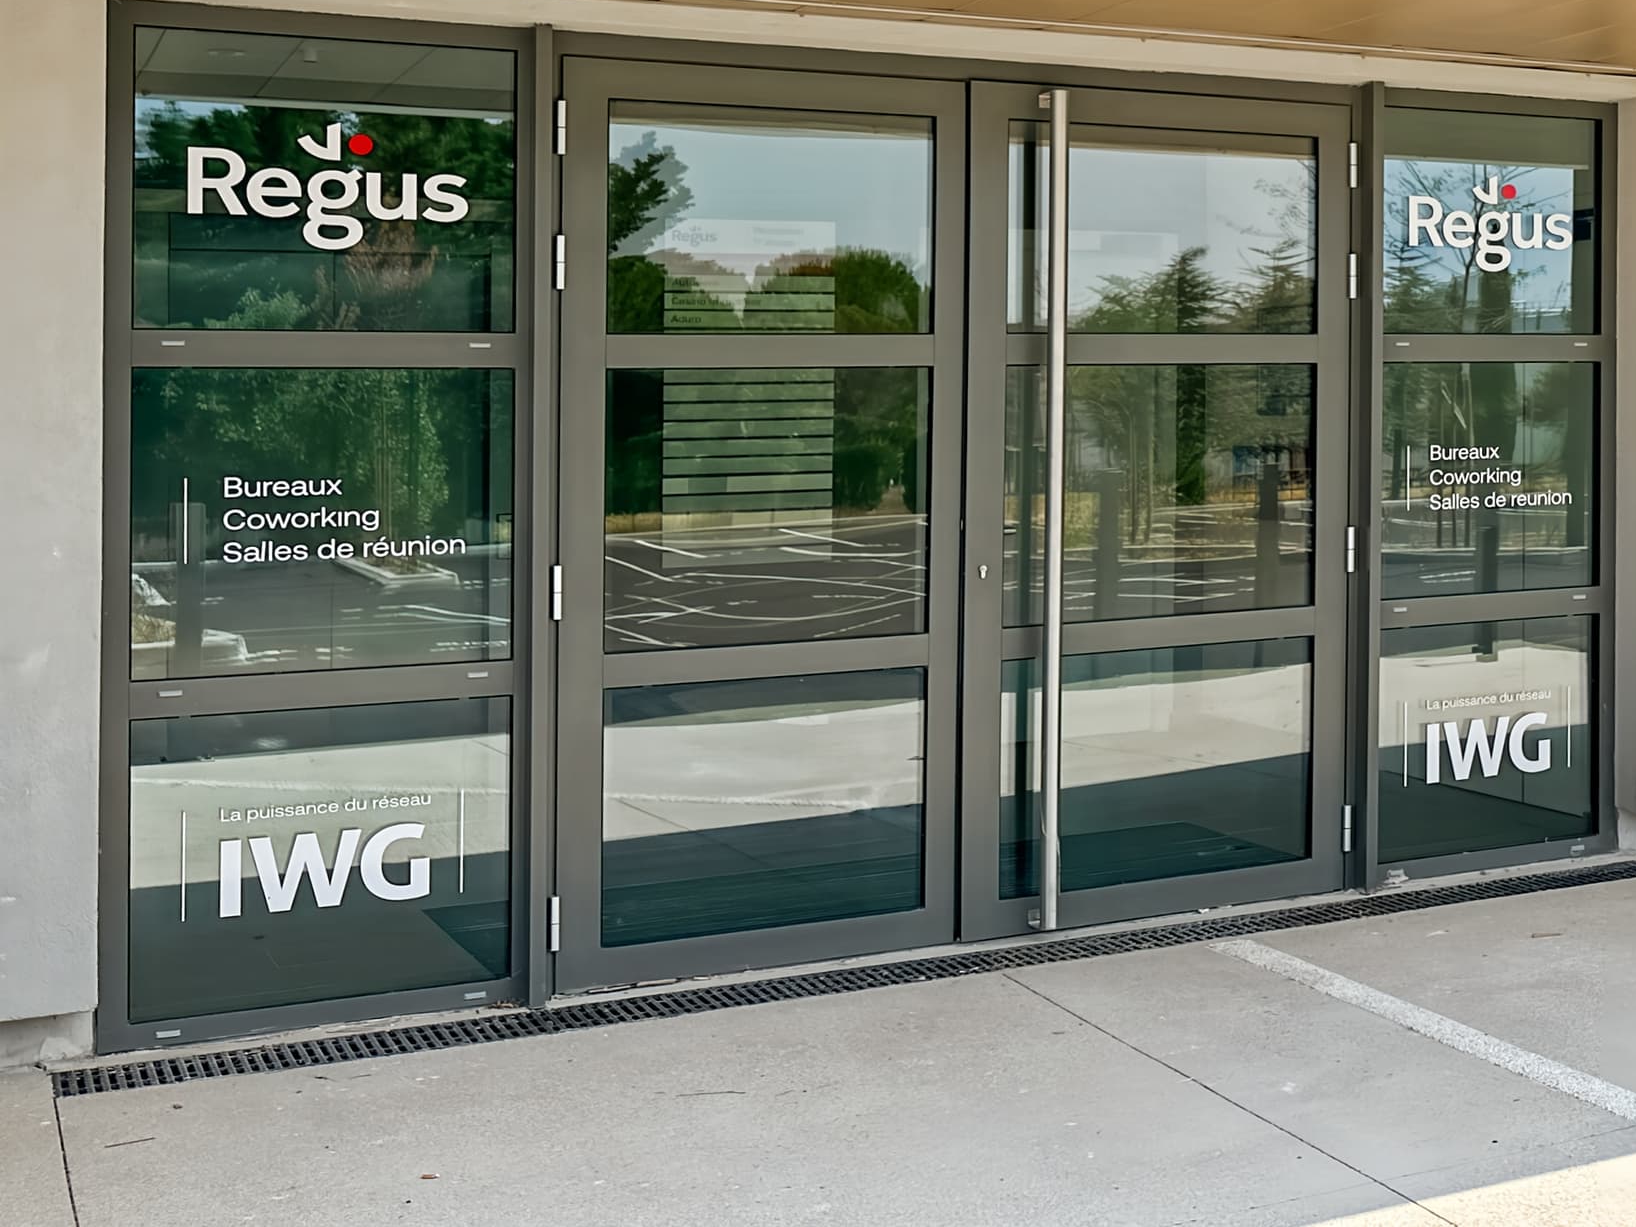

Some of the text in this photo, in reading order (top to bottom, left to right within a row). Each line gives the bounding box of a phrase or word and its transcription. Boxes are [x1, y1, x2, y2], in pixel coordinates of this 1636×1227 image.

[186, 122, 469, 251] Regus
[1408, 175, 1574, 272] Regus
[1430, 444, 1500, 461] Bureaux
[223, 476, 343, 498] Bureaux
[1429, 467, 1522, 487] Coworking
[1429, 493, 1480, 511] Salles
[1484, 491, 1507, 508] de
[223, 506, 380, 531] Coworking
[223, 534, 466, 564] Salles de réunion
[1426, 688, 1551, 711] La puissance du réseau
[1425, 712, 1552, 785] IWG
[220, 794, 432, 823] La puissance du réseau
[219, 822, 431, 918] IWG
